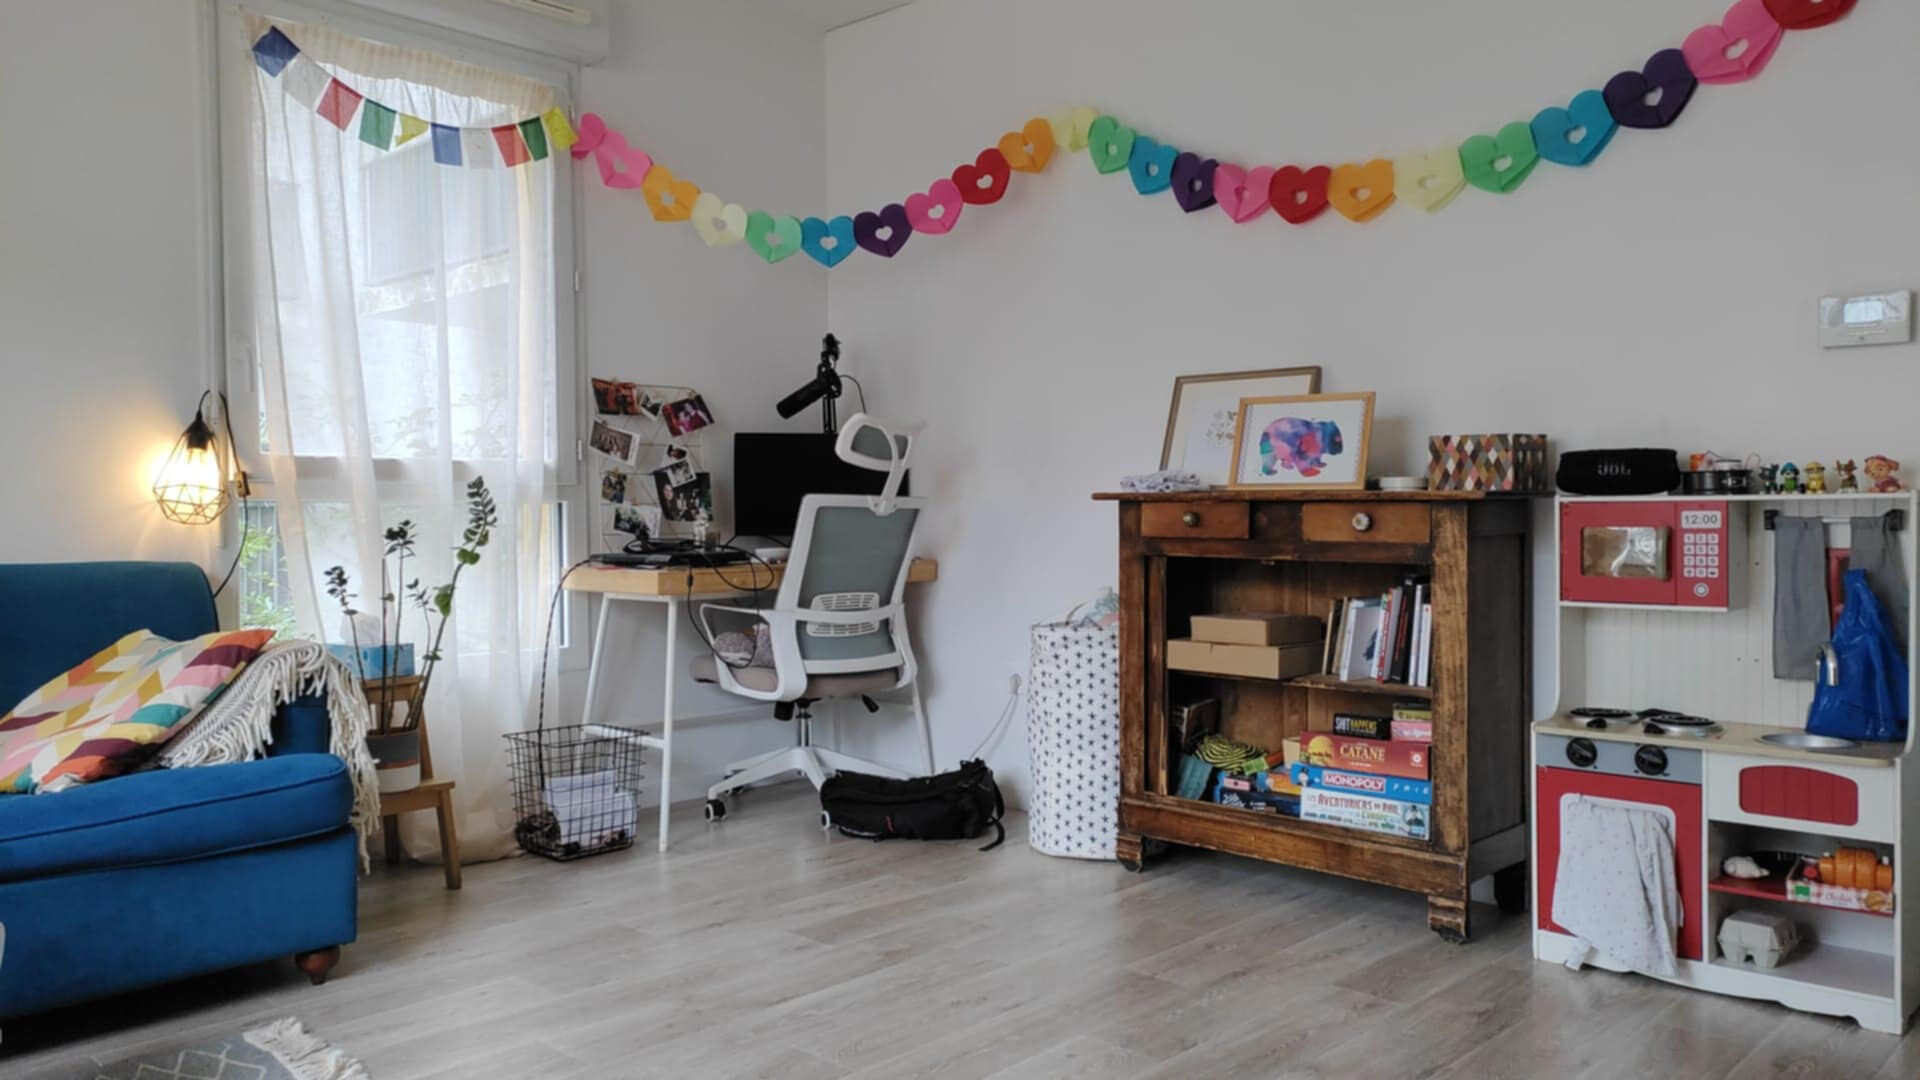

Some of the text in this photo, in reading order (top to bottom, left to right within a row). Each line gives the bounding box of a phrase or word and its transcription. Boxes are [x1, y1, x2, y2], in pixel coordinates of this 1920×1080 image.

[1597, 463, 1631, 476] JBL
[1684, 514, 1718, 525] 12:00
[1350, 719, 1377, 730] HAPPENS
[1340, 743, 1385, 762] CATANE
[1324, 774, 1385, 792] MONOPOLY
